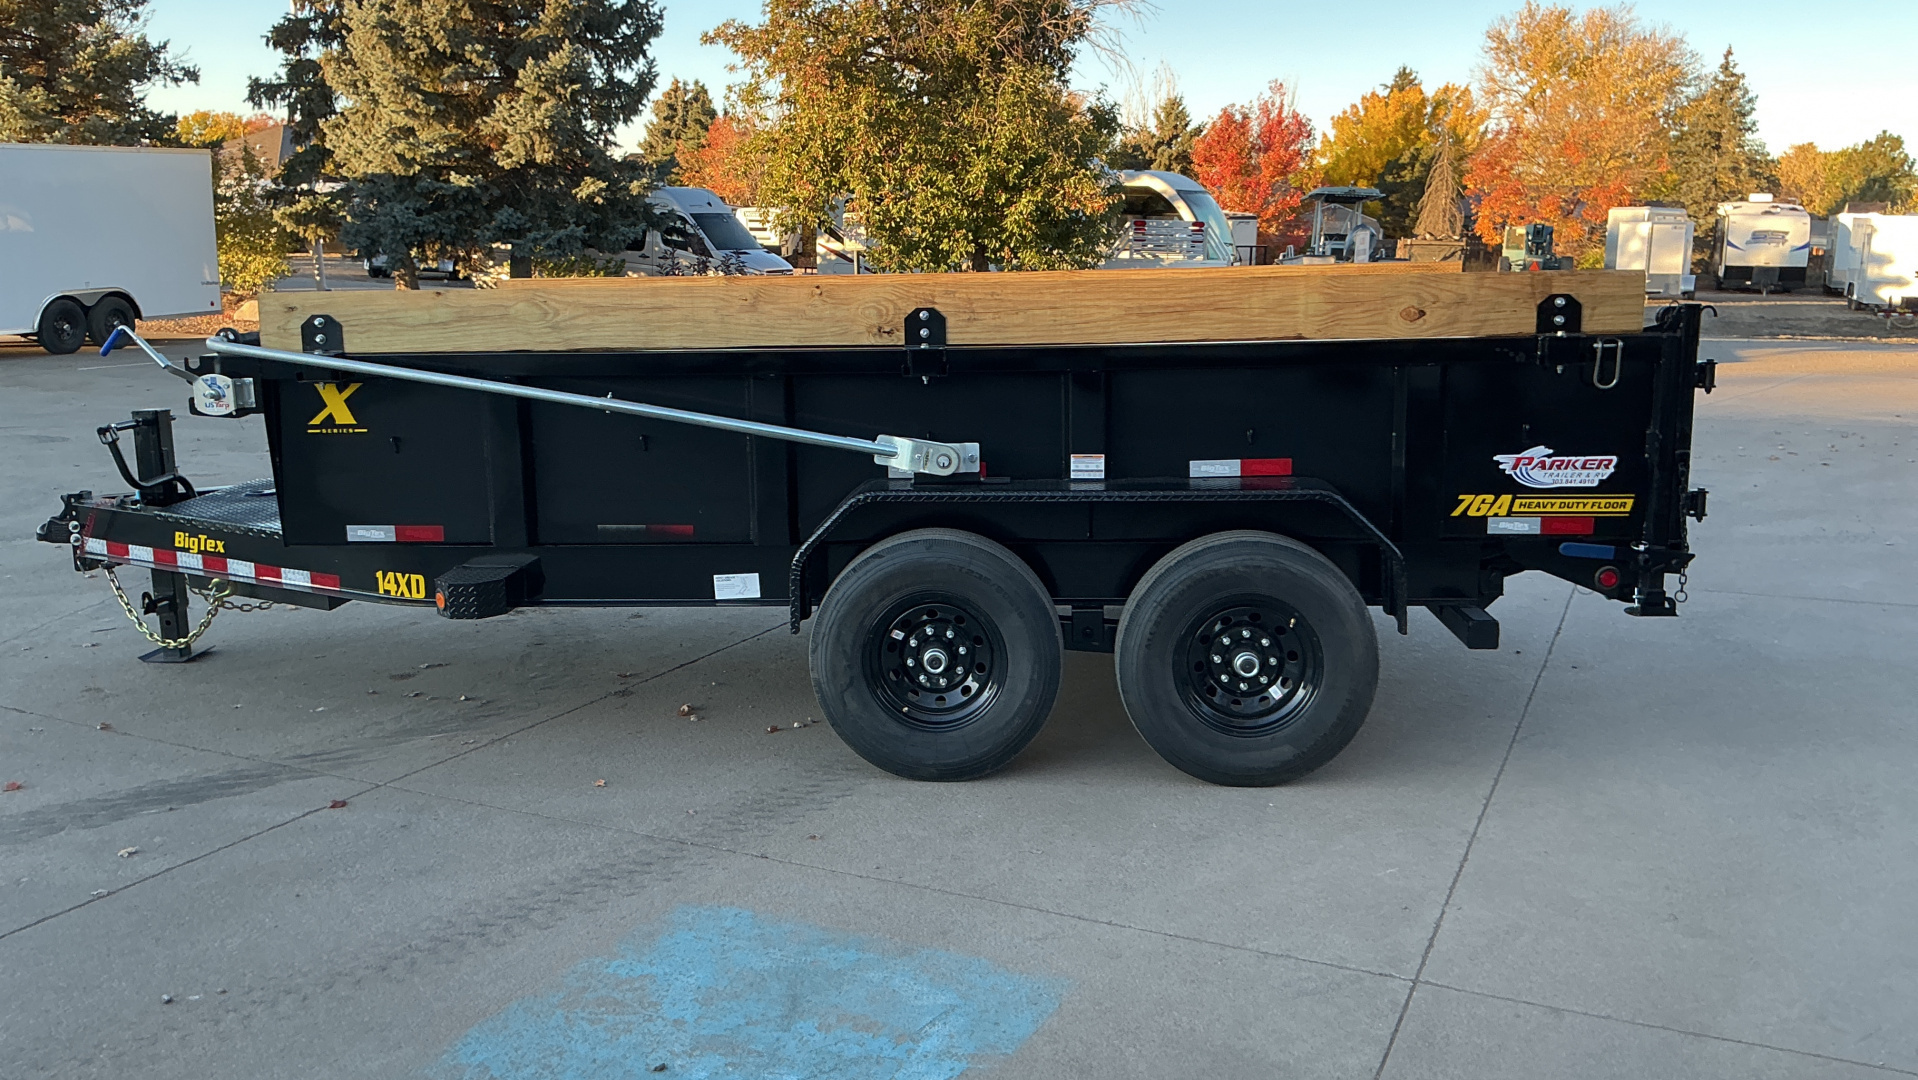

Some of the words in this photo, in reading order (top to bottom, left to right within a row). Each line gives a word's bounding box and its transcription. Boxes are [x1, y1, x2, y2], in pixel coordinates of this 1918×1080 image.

[307, 382, 364, 425] X
[1510, 456, 1614, 471] PARKER
[1449, 494, 1513, 517] 7GA
[1518, 501, 1557, 510] HEAVY
[1558, 501, 1589, 510] DUTY
[1590, 501, 1628, 510] FLOOR
[174, 530, 226, 554] BigTex
[375, 570, 426, 599] 14XD
